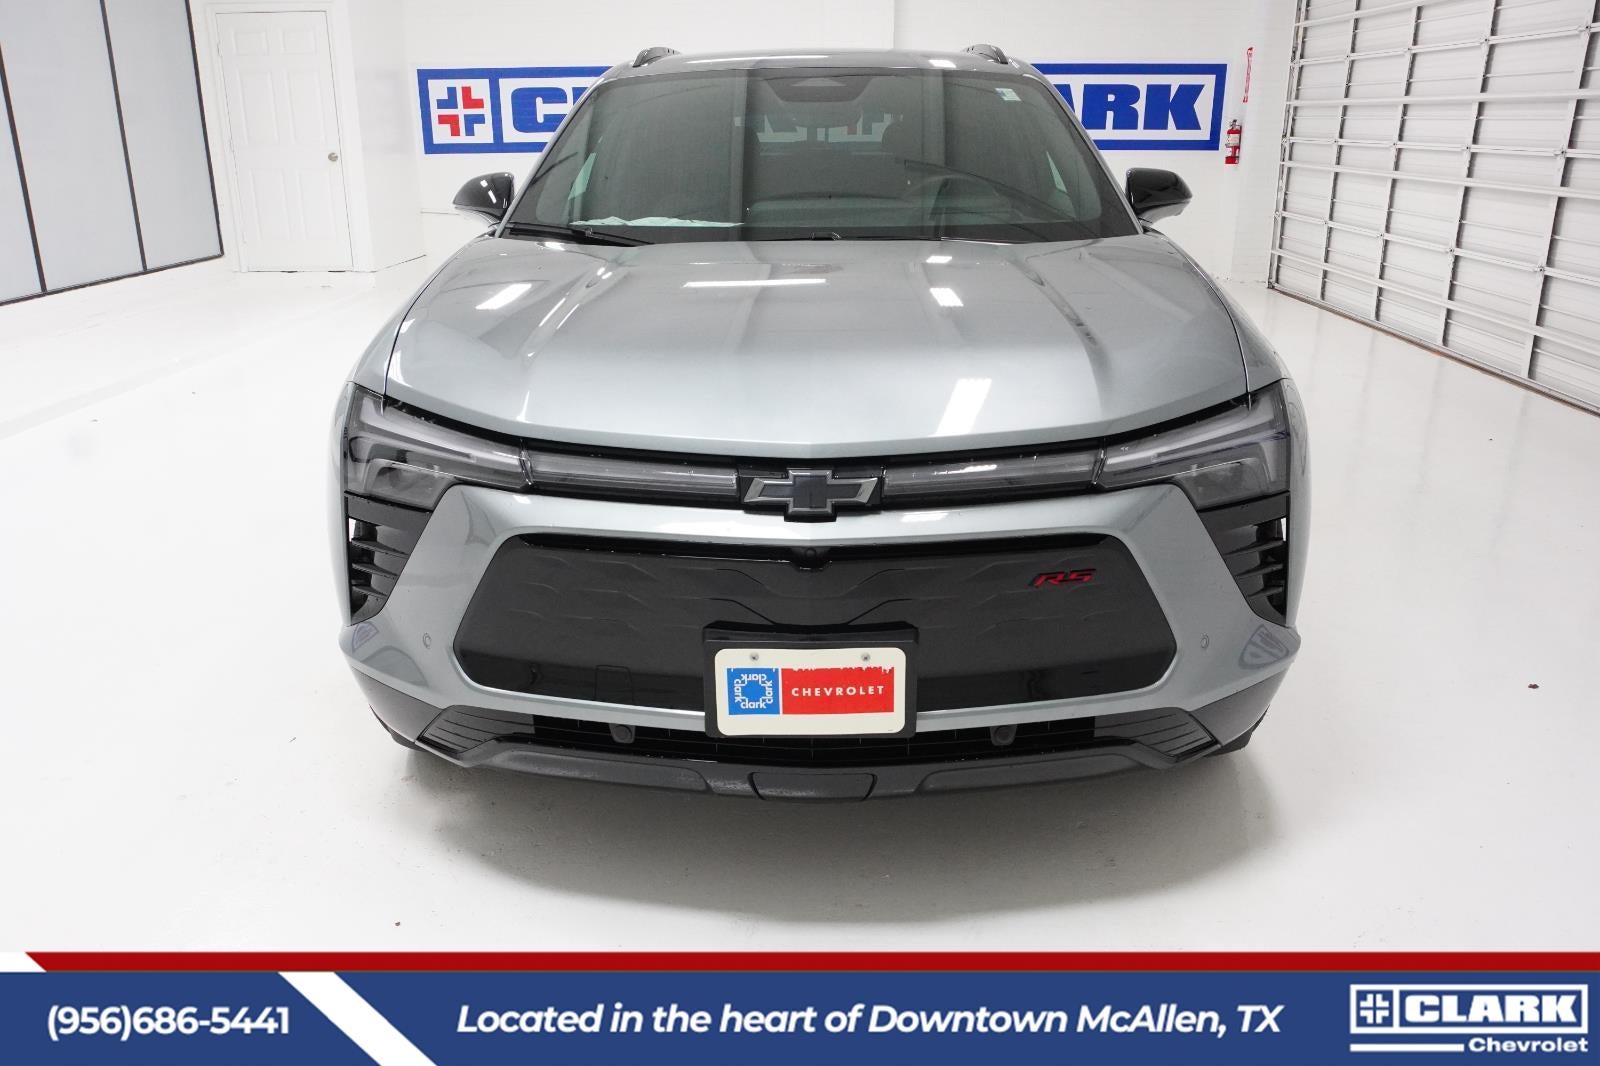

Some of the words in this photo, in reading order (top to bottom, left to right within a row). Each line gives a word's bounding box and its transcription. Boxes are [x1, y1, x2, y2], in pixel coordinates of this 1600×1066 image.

[1032, 568, 1096, 588] RS
[791, 685, 885, 697] CHEVROLET
[740, 697, 767, 709] clark
